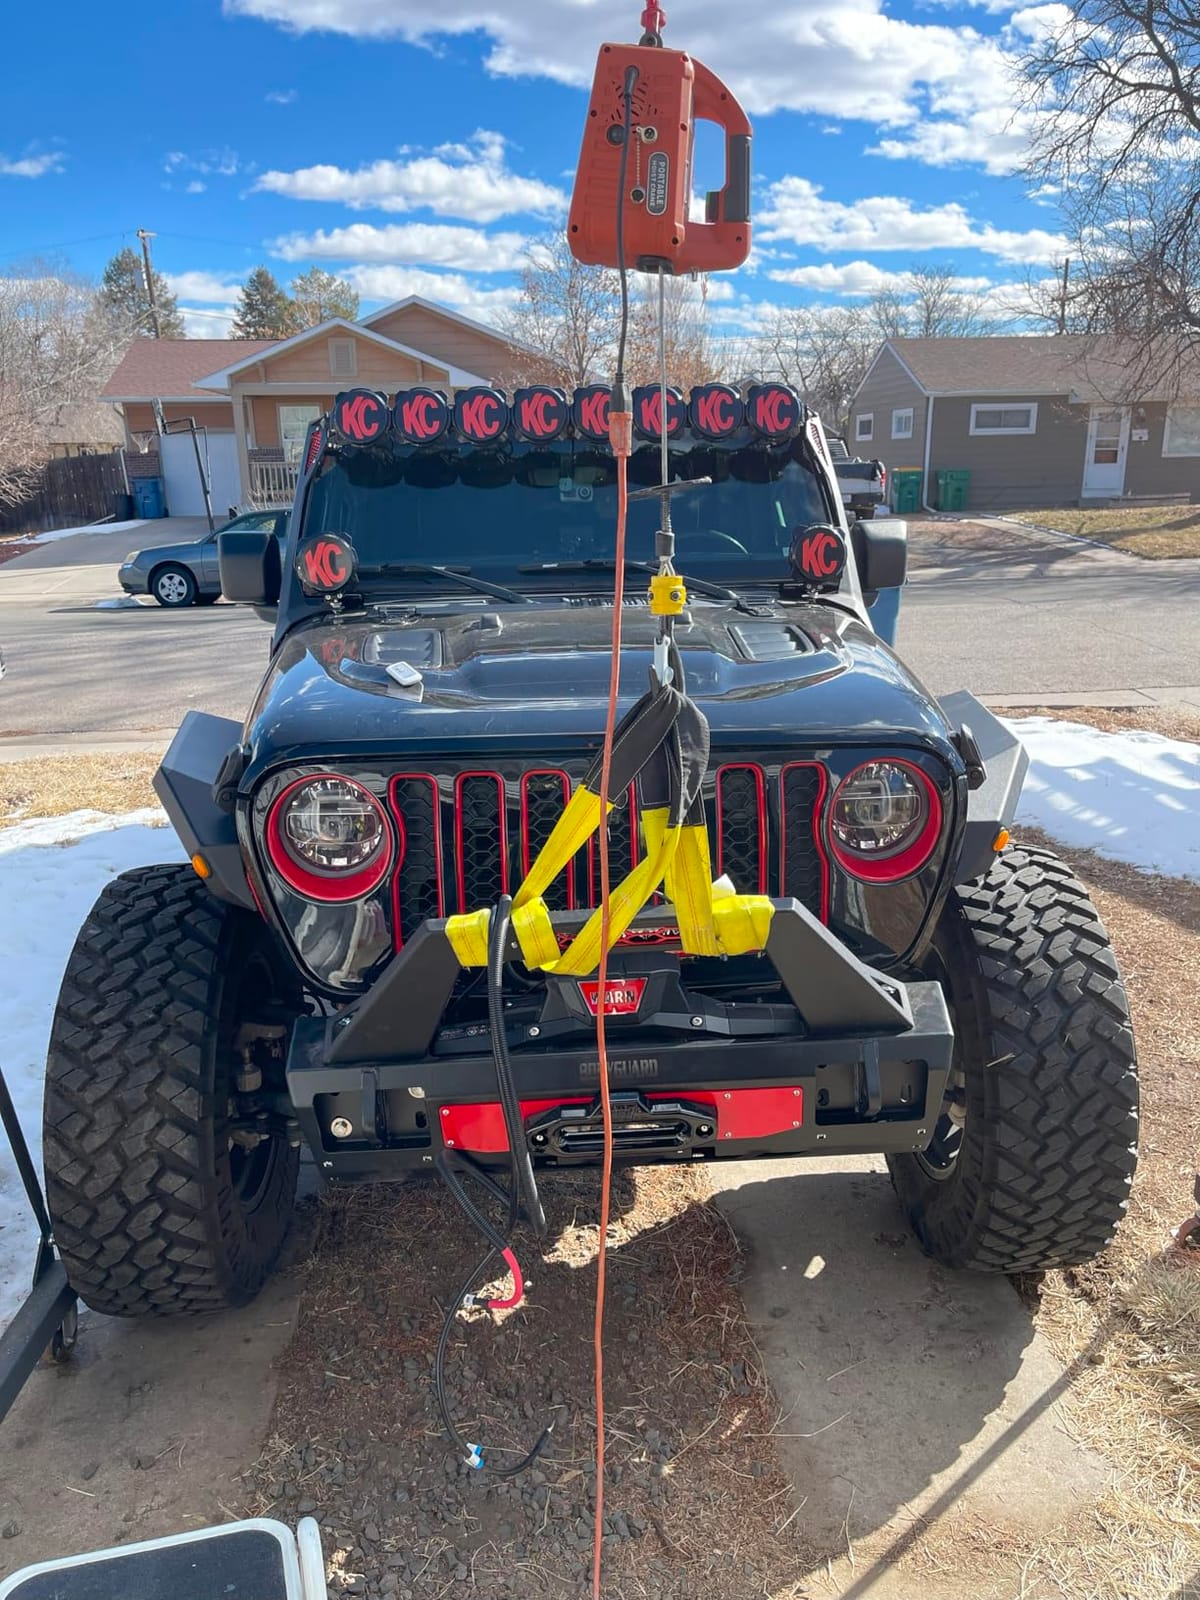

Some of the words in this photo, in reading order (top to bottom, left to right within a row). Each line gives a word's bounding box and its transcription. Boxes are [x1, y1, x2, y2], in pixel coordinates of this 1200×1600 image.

[656, 161, 666, 205] PORTABLE
[343, 397, 377, 438] KC
[404, 396, 438, 436] KC
[463, 397, 498, 436] KC
[522, 394, 557, 434] KC
[642, 393, 676, 432] KC
[699, 392, 732, 431] KC
[758, 392, 789, 430] KC
[306, 543, 345, 586] KC
[803, 533, 836, 576] KC
[590, 991, 635, 1005] WARN
